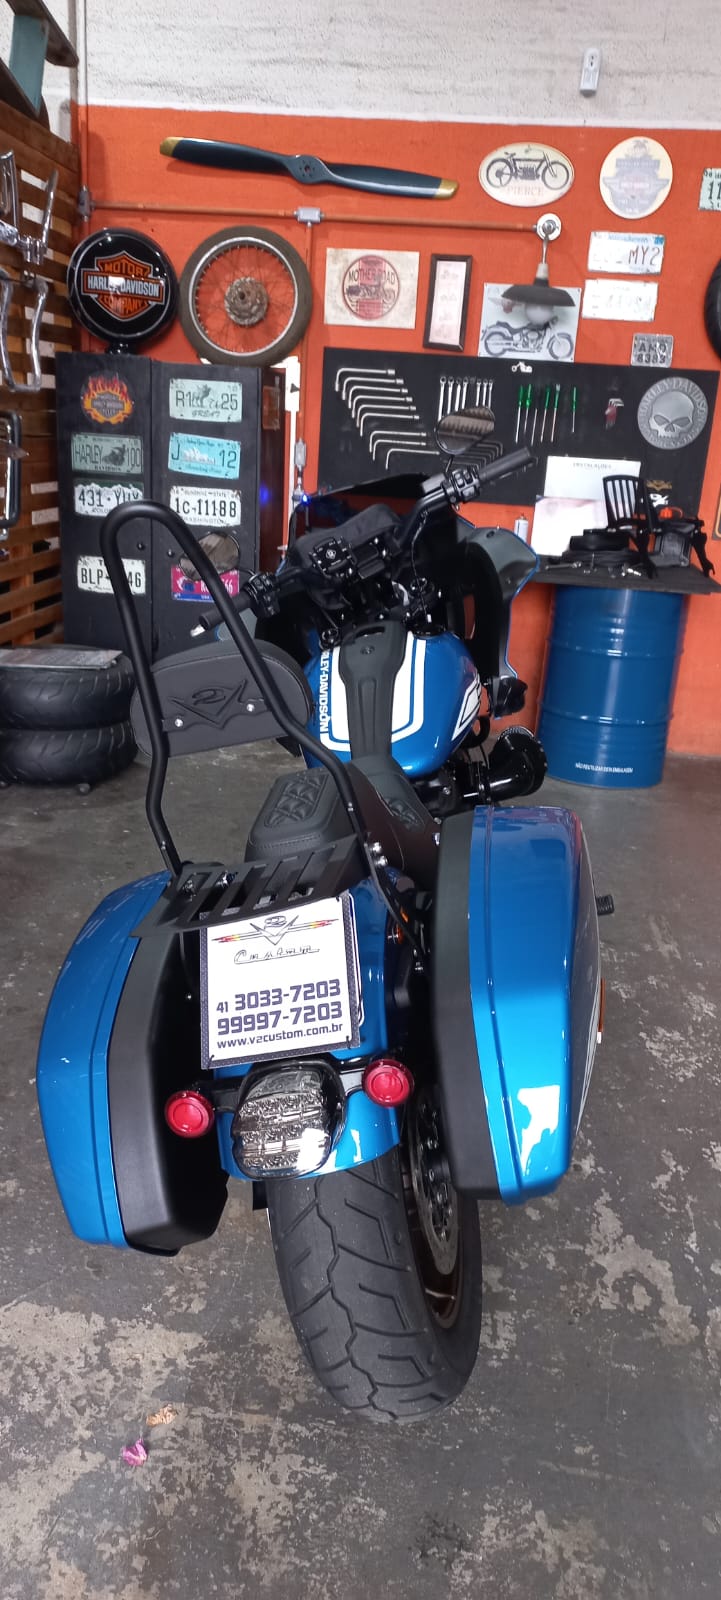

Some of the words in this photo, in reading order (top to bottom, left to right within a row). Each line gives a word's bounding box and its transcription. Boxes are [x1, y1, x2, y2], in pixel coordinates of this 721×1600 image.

[104, 259, 142, 276] MOTOR
[74, 444, 103, 464] HARLEY
[219, 449, 237, 469] 12
[216, 1001, 229, 1013] 41
[234, 978, 341, 1012] 3033-7203
[217, 1000, 343, 1036] 99997-7203
[216, 1023, 343, 1049] www.v2custom.com.br
